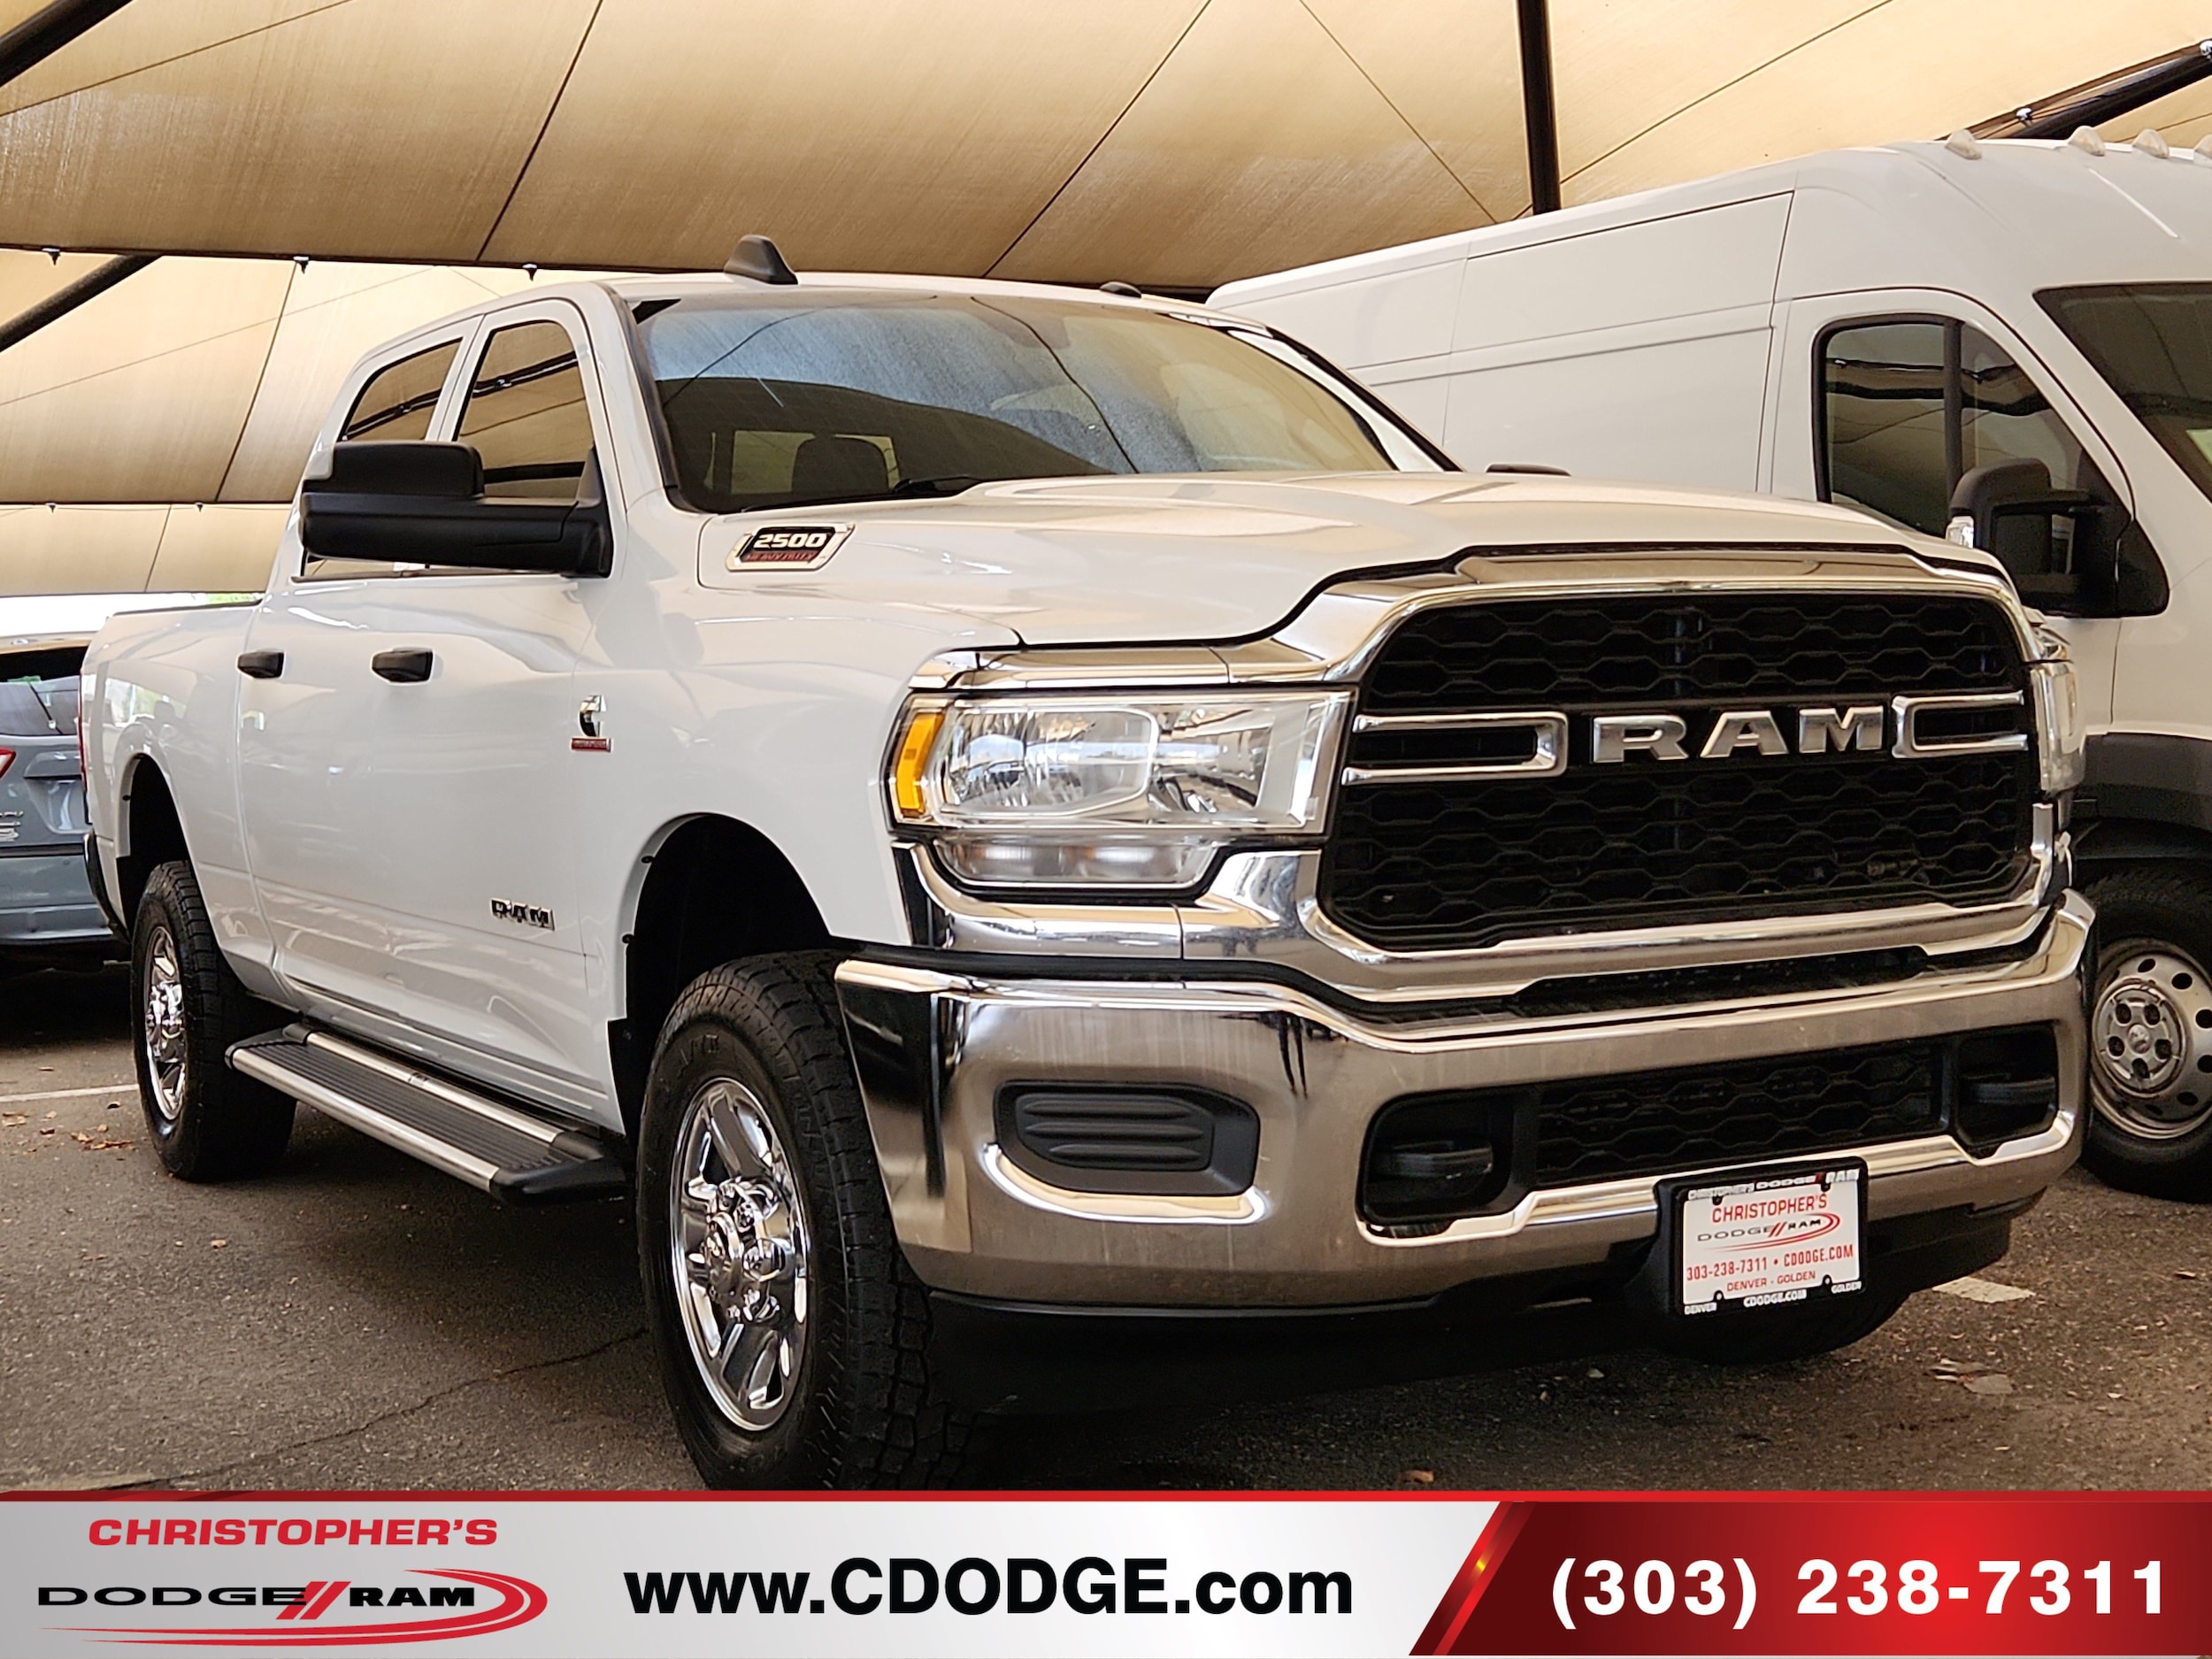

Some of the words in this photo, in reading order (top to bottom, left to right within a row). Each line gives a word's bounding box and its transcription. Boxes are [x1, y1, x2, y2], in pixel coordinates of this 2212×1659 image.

[753, 533, 827, 549] 2500
[1593, 705, 1884, 764] RAM
[490, 897, 555, 931] RAM
[1756, 1175, 1816, 1190] DODGE
[1825, 1169, 1860, 1184] RAM
[1712, 1194, 1827, 1224] CHRISTOPHER'S
[1697, 1225, 1775, 1242] DODGE
[1787, 1218, 1822, 1231] RAM
[1686, 1256, 1768, 1281] 303-238-7311
[1783, 1244, 1854, 1268] CDODGE.COM
[1726, 1275, 1768, 1292] DENVER
[1777, 1270, 1816, 1284] GOLDEN
[1684, 1302, 1717, 1316] DENVER
[1743, 1289, 1808, 1308] CDODGE.COM
